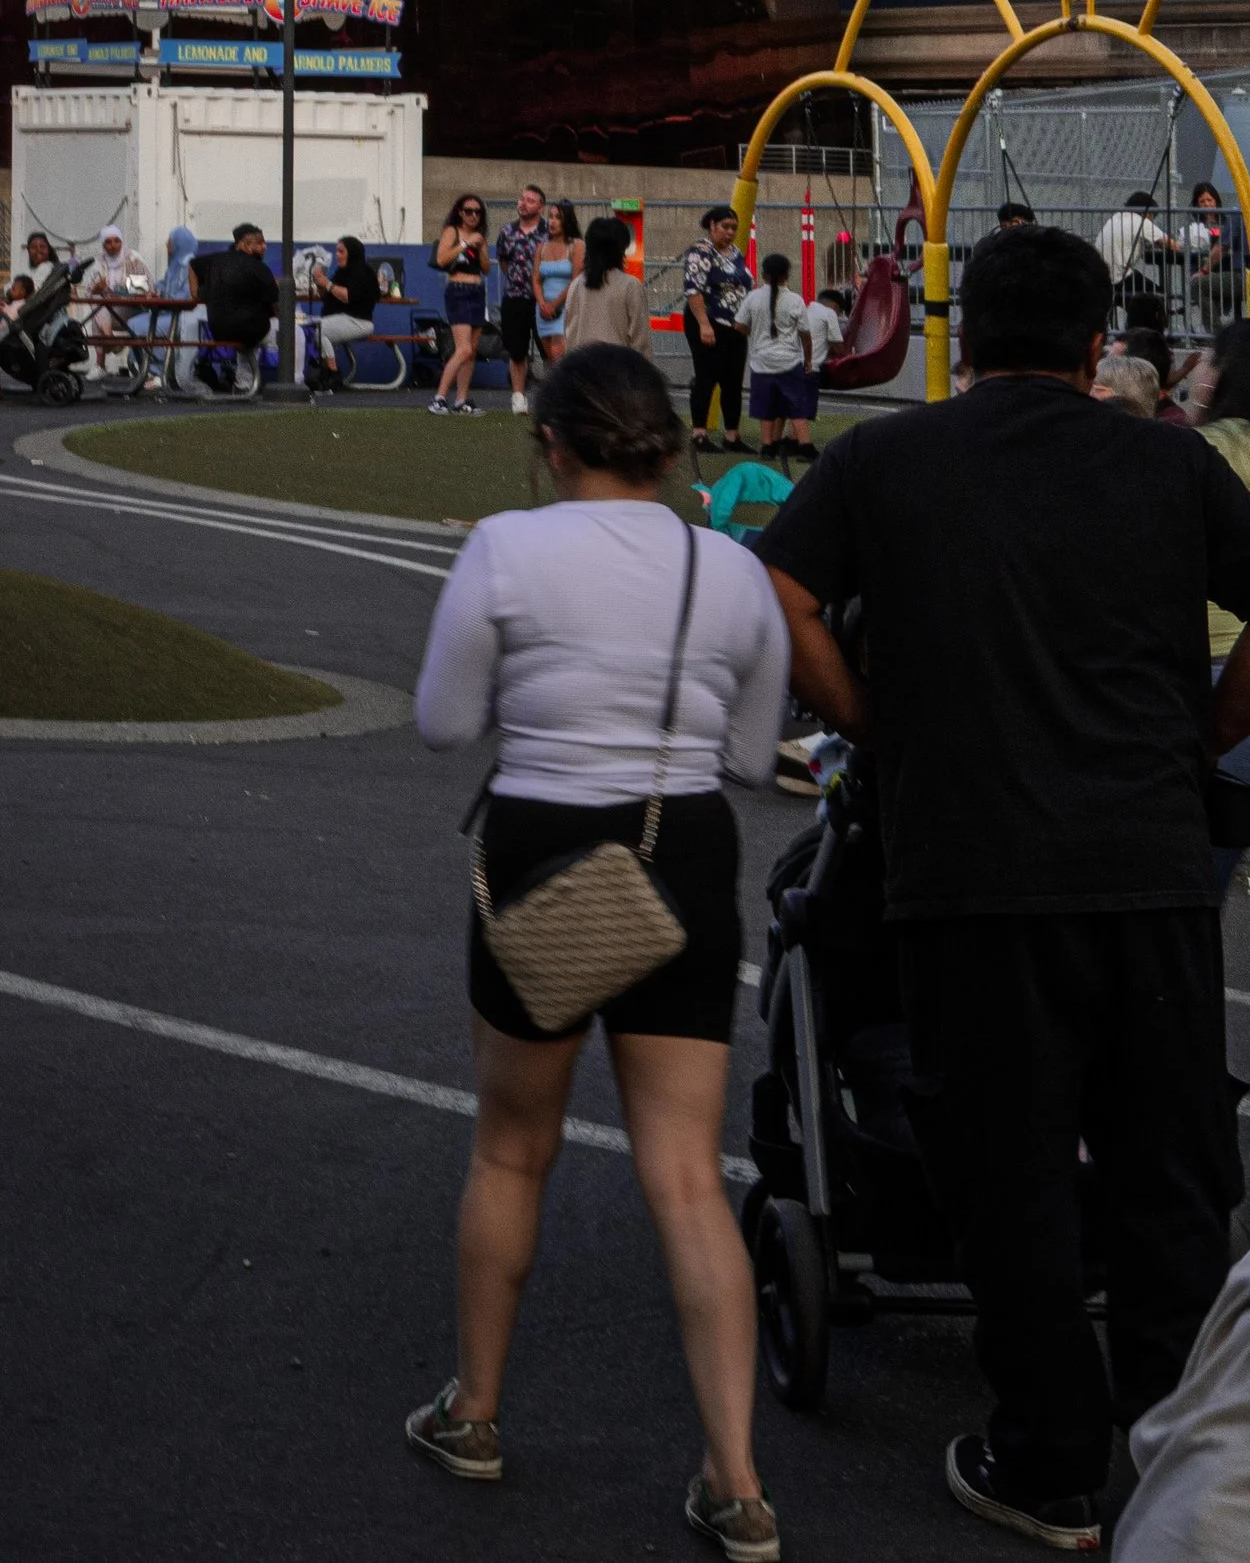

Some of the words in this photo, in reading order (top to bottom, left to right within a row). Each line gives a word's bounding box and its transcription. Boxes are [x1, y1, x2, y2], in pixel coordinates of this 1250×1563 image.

[178, 44, 238, 61] LEMONADE
[243, 45, 267, 63] AND
[293, 55, 334, 71] ARNOLD
[338, 55, 391, 72] PALMERS
